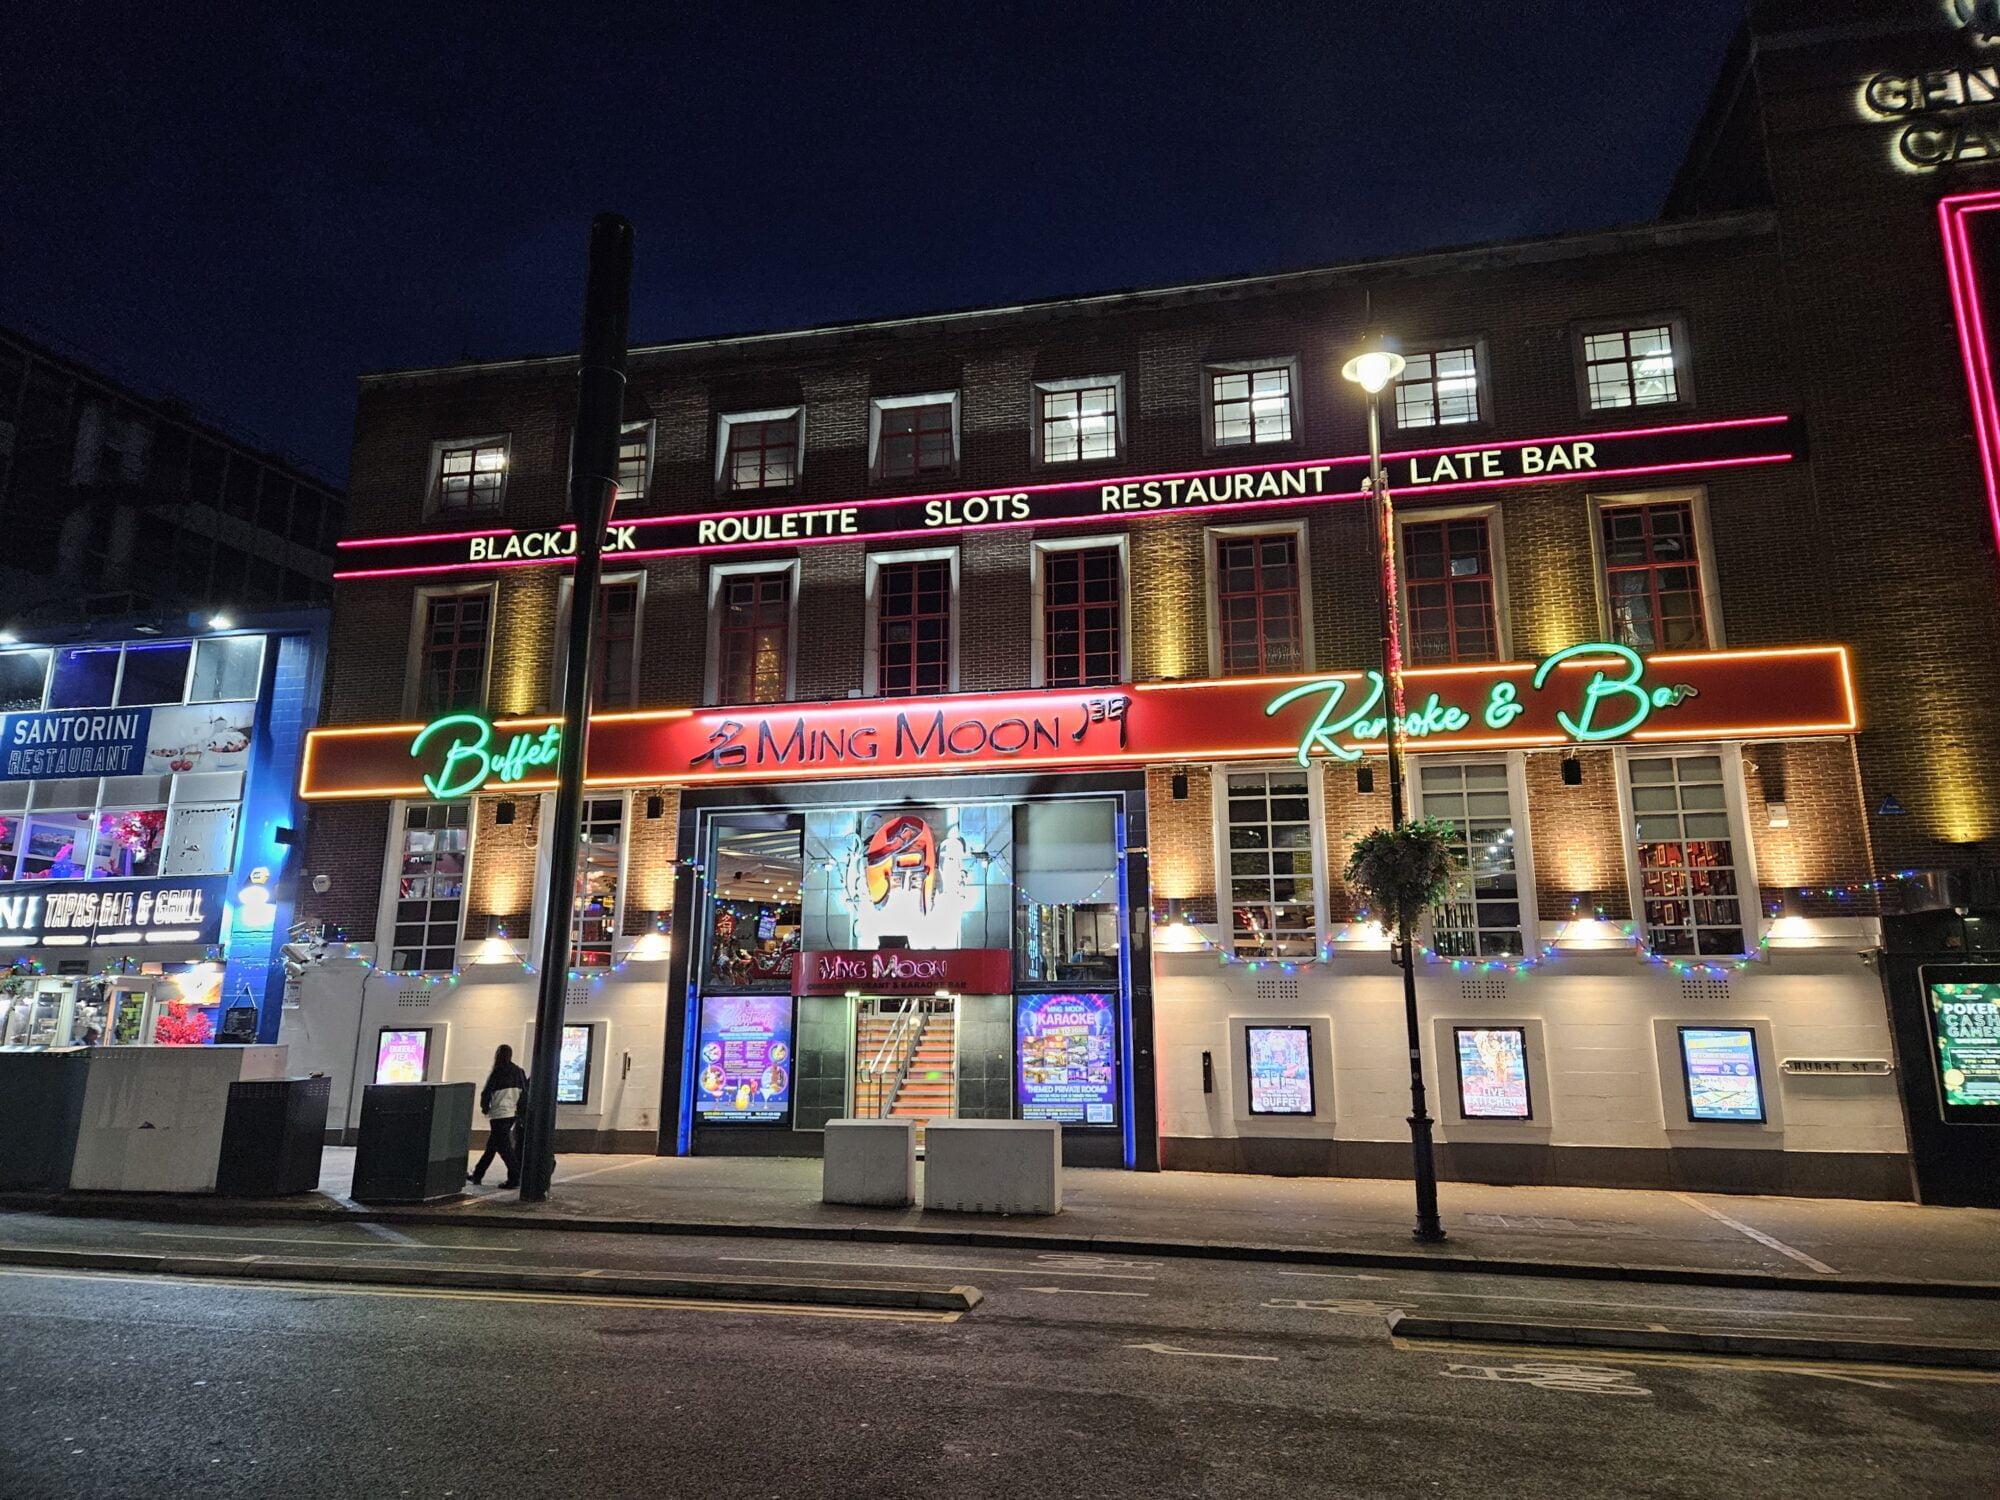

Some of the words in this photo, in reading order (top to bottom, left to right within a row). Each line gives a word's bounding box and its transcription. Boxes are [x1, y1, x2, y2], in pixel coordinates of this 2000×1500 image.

[469, 525, 637, 560] BLACKJCK
[699, 508, 858, 544] ROULETTE
[924, 493, 1031, 526] SLOTS
[1101, 466, 1331, 512] RESTAURANT
[1409, 450, 1504, 484] LATE
[1521, 441, 1598, 475] BAR
[1484, 681, 1523, 729] &
[1534, 642, 1699, 741] Bar
[13, 714, 140, 745] SANTORINI
[7, 745, 134, 775] RESTAURANT
[410, 713, 561, 799] Buffet
[44, 892, 99, 928] TAPAS
[98, 892, 135, 926] BAR
[153, 888, 204, 926] GRILL
[1942, 1003, 1999, 1015] POKER
[1036, 1012, 1096, 1025] KARAOKE
[1945, 1014, 2000, 1027] CASH
[1947, 1026, 2000, 1038] GAMES
[1793, 1062, 1841, 1072] HURST
[1852, 1062, 1868, 1072] ST
[1081, 1085, 1108, 1093] ROOMS
[1483, 1087, 1505, 1097] LIVE
[1262, 1096, 1301, 1107] BUFFET
